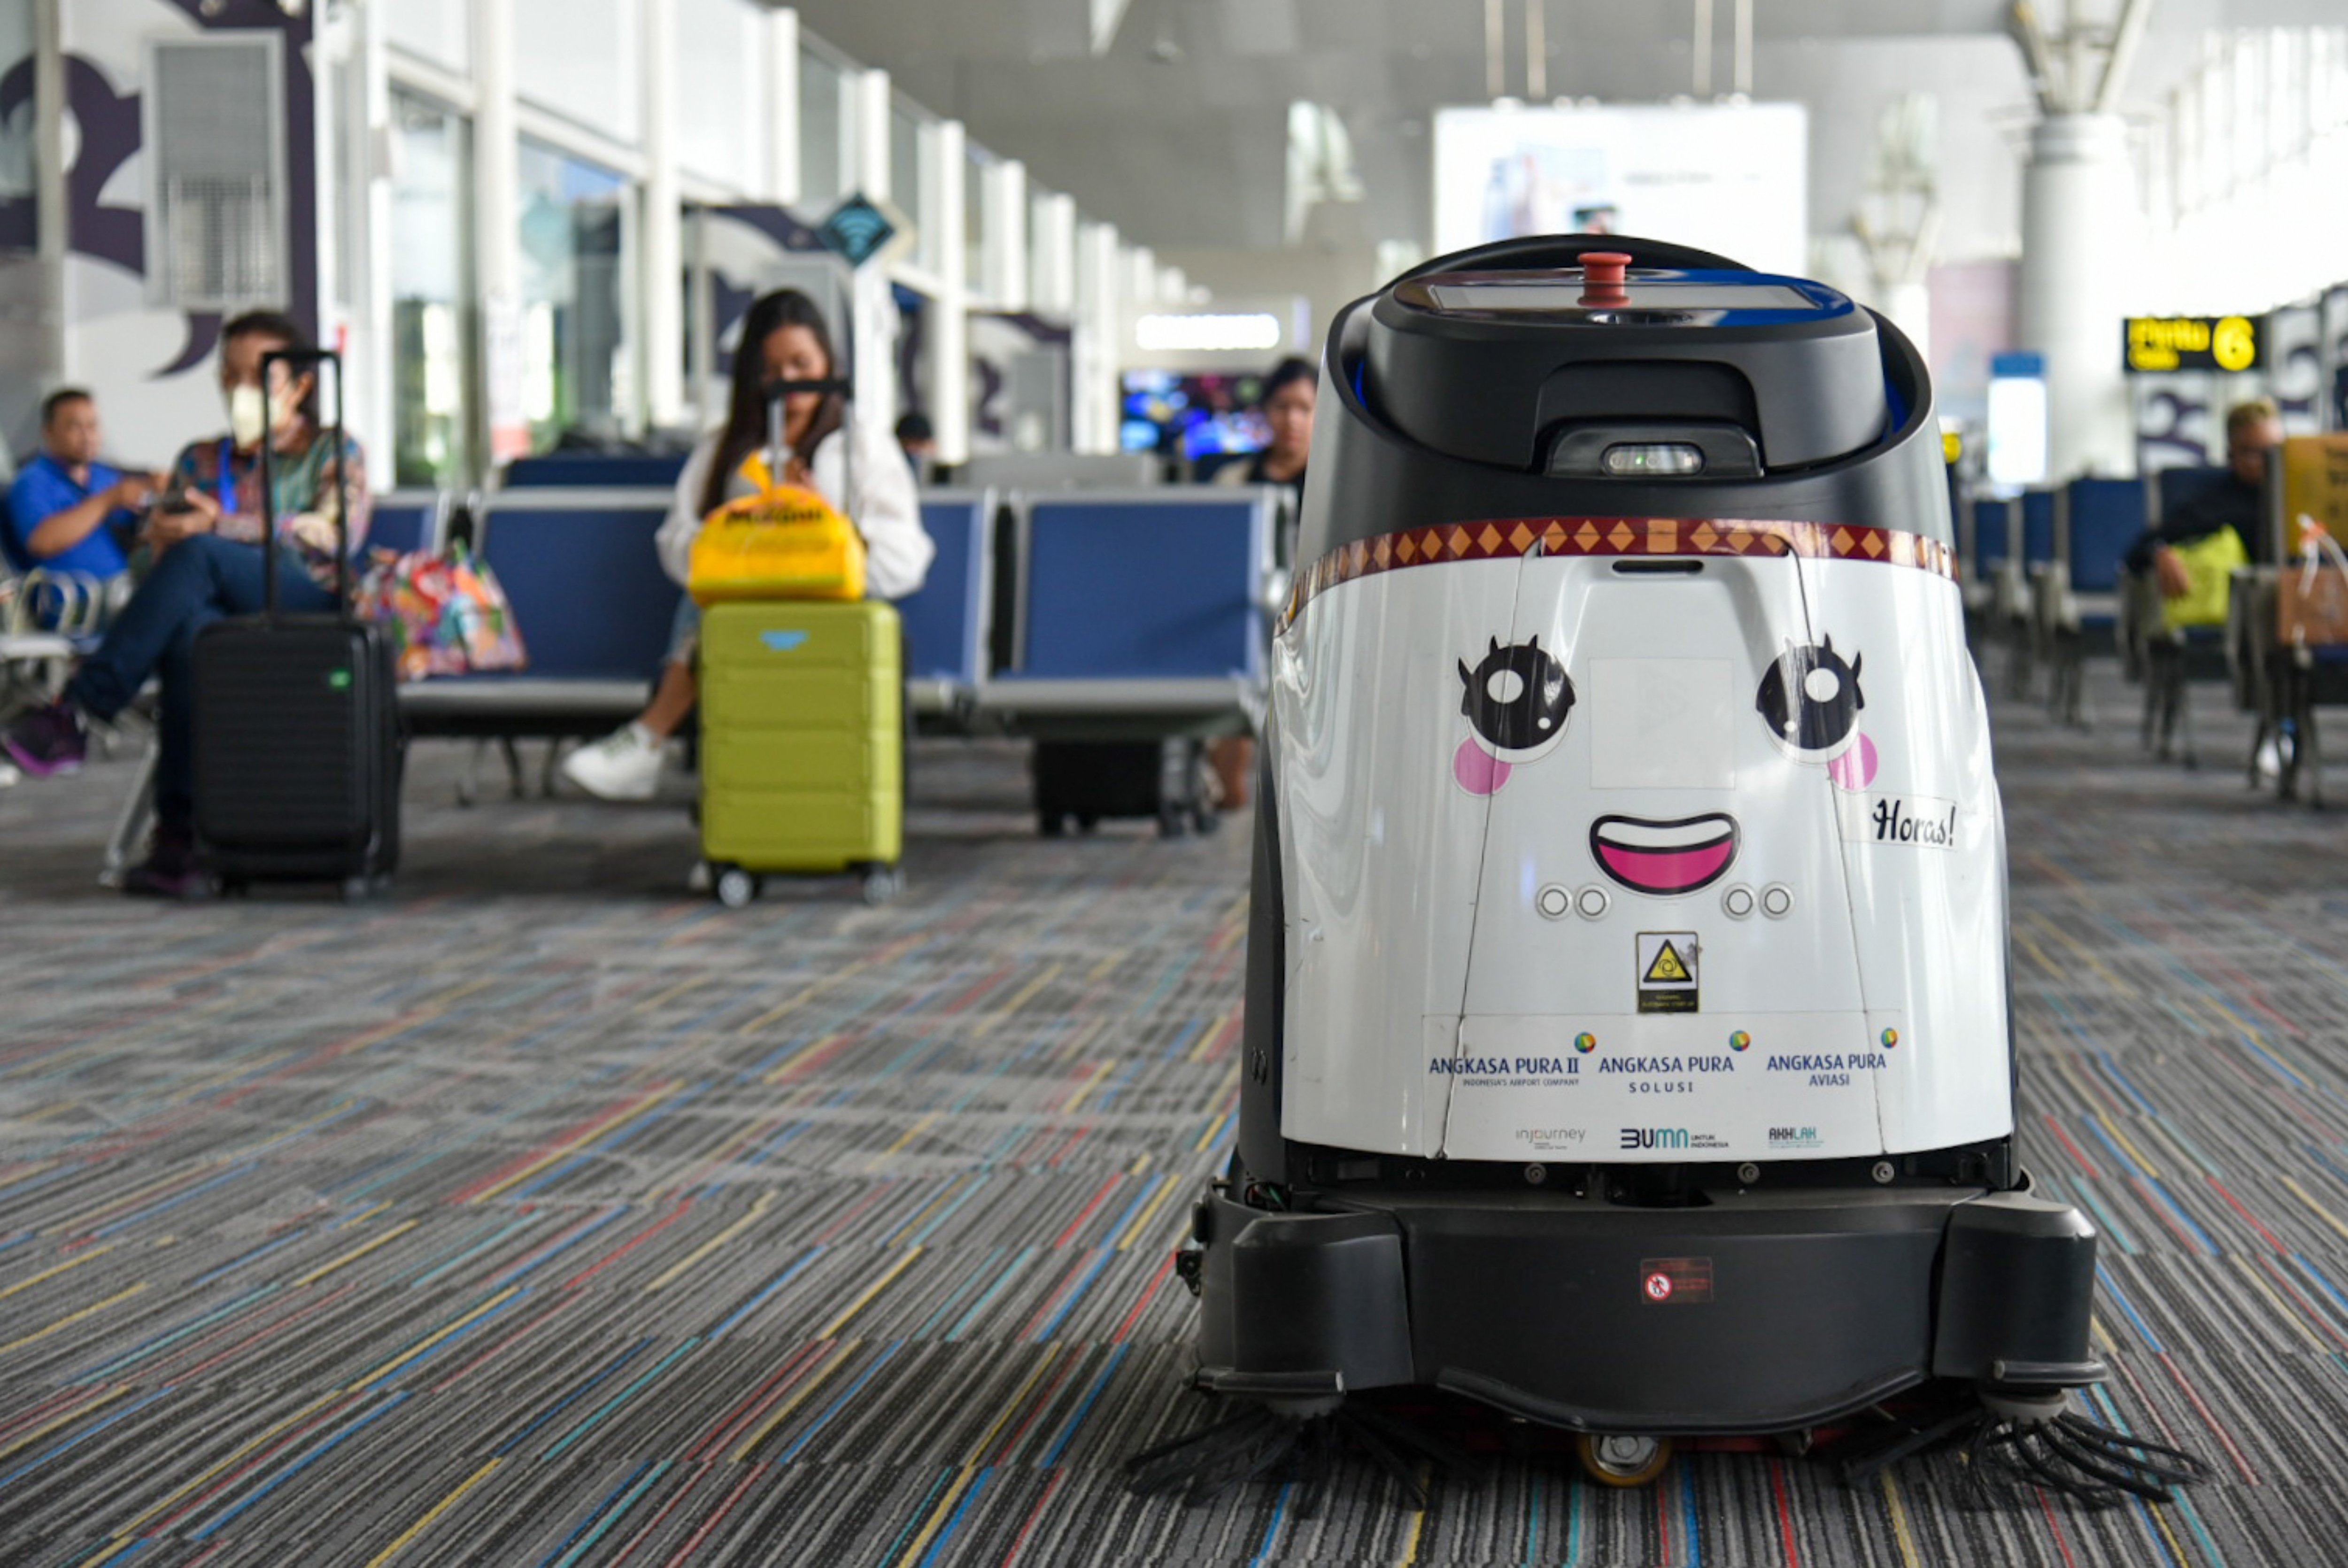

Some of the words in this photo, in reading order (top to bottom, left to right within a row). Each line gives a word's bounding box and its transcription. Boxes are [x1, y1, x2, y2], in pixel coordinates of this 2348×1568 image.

[2213, 317, 2255, 371] 6
[1872, 798, 1956, 846] Horas!
[1429, 1057, 1510, 1074] ANGKASA
[1516, 1057, 1562, 1074] PURA
[1567, 1057, 1580, 1074] II
[1599, 1057, 1683, 1073] ANGKASA
[1688, 1056, 1734, 1072] PURA
[1767, 1055, 1844, 1071] ANGKASA
[1848, 1053, 1886, 1069] PURA
[1629, 1081, 1693, 1093] SOLUSI
[1808, 1074, 1850, 1086] AVIASI
[1515, 1128, 1585, 1143] injourney
